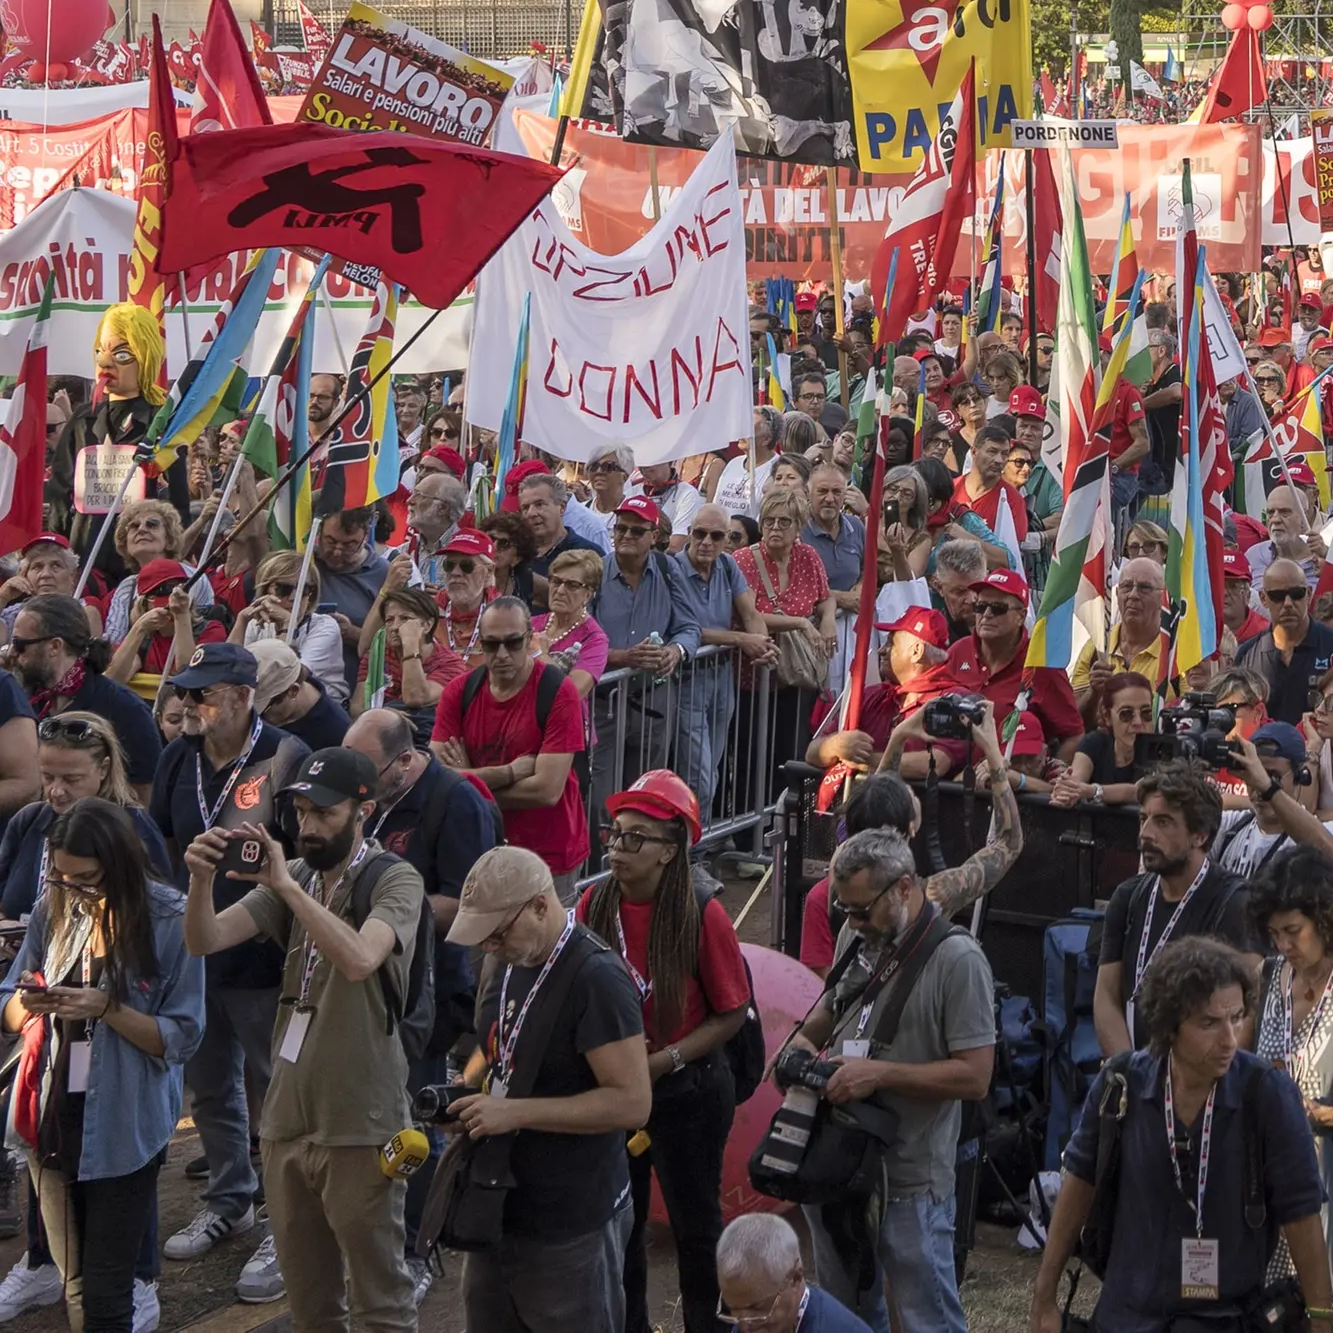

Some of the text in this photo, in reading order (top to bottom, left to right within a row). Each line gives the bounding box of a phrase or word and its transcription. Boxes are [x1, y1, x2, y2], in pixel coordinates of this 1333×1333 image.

[322, 69, 485, 145] Salari e pensioni più alti
[329, 33, 494, 131] LAVORO
[29, 138, 39, 154] 5
[865, 83, 1018, 160] PAA
[1015, 125, 1114, 142] PORDENONE
[774, 187, 825, 223] DEL
[0, 237, 103, 311] sanità
[878, 958, 901, 984] EOS
